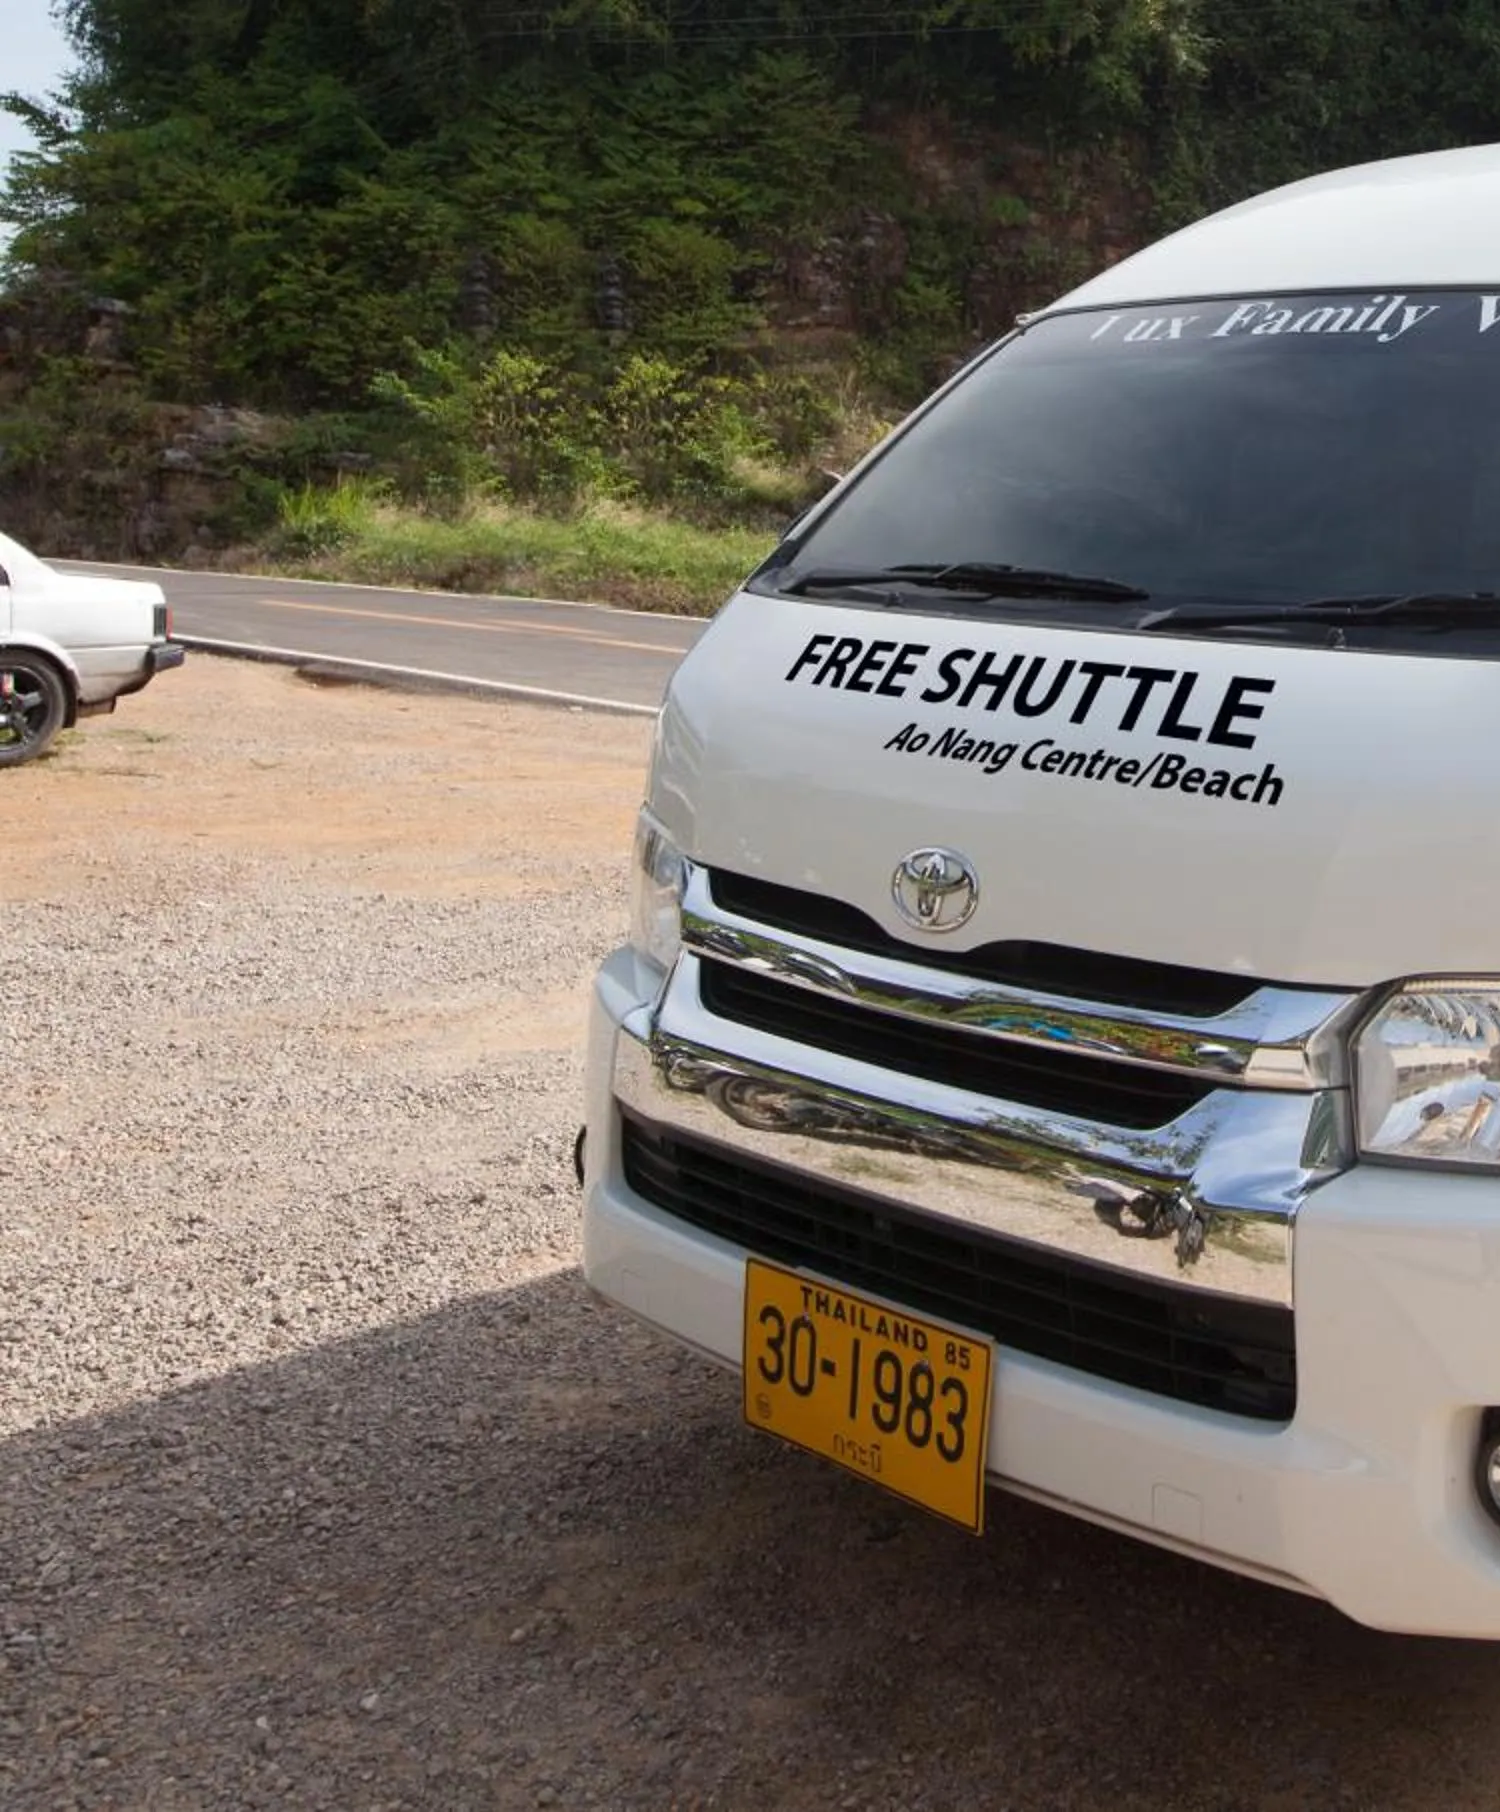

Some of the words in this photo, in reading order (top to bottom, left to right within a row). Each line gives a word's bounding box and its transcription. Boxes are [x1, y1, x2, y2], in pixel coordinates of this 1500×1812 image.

[1211, 295, 1438, 343] Family
[785, 634, 928, 698] FREE
[921, 648, 1276, 750] SHUTTLE
[884, 722, 931, 753] Ao
[928, 727, 1018, 774] Nang
[1021, 738, 1284, 805] Centre/Beach
[800, 1286, 929, 1352] THAILAND
[944, 1342, 971, 1371] 85
[757, 1304, 969, 1463] 30-1983
